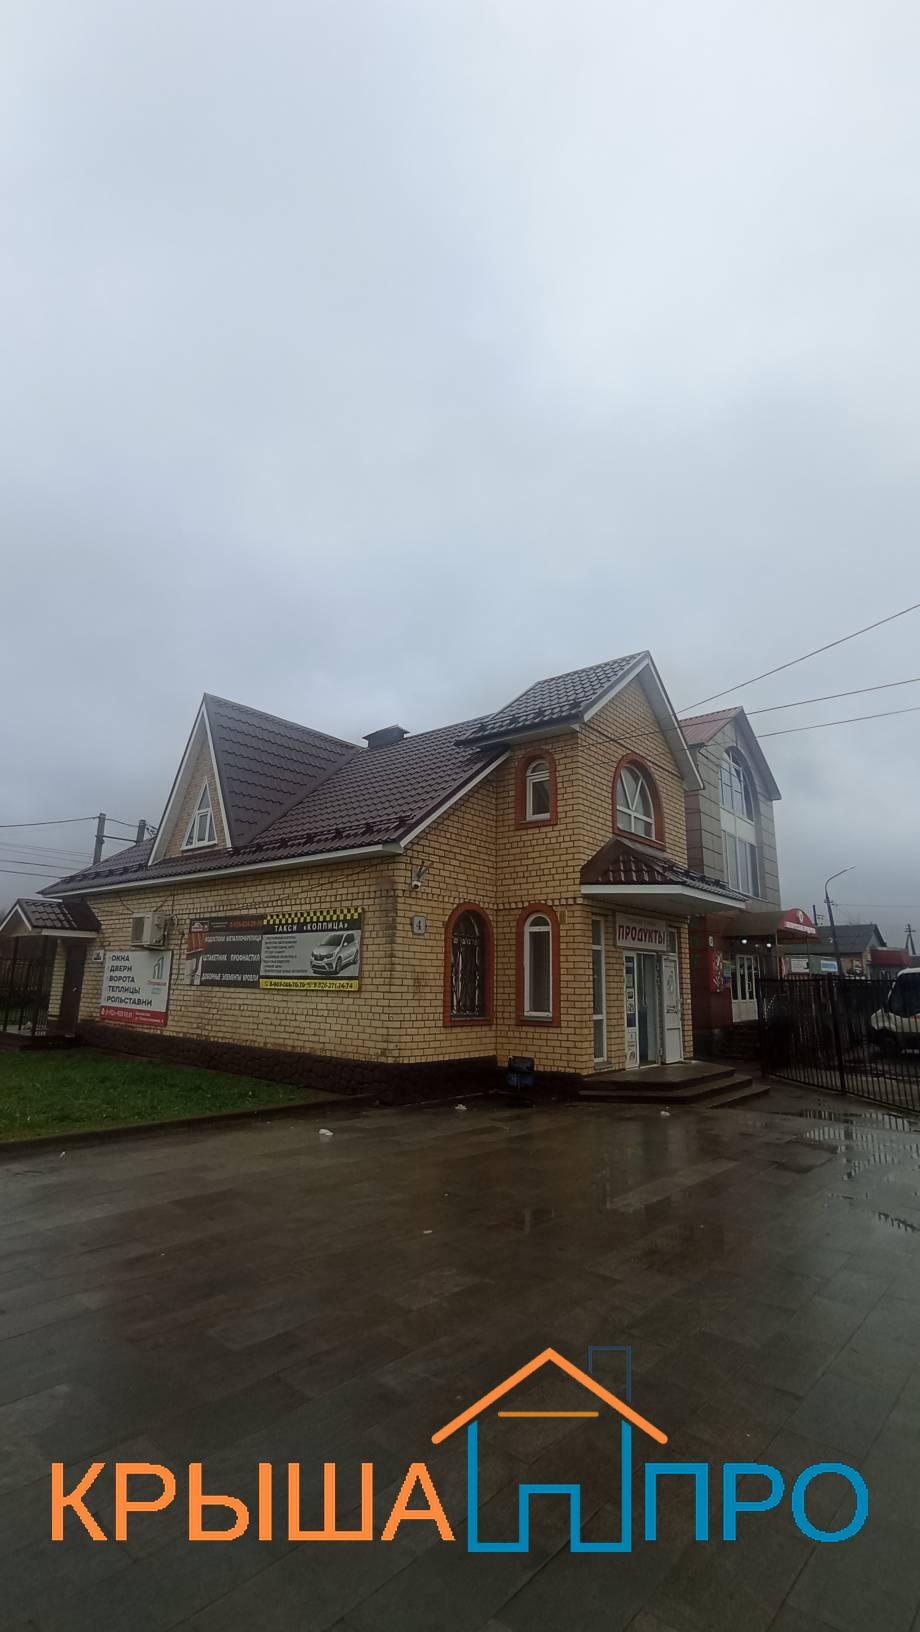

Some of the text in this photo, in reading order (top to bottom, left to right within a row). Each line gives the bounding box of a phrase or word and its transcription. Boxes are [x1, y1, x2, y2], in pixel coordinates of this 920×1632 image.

[415, 919, 421, 930] 4
[618, 925, 665, 945] ПРОДУКТЫ
[109, 975, 135, 983] ВОРОТА
[108, 985, 140, 994] ТЕПЛИЦЫ
[106, 996, 153, 1007] РОЛЬСТАВНИ
